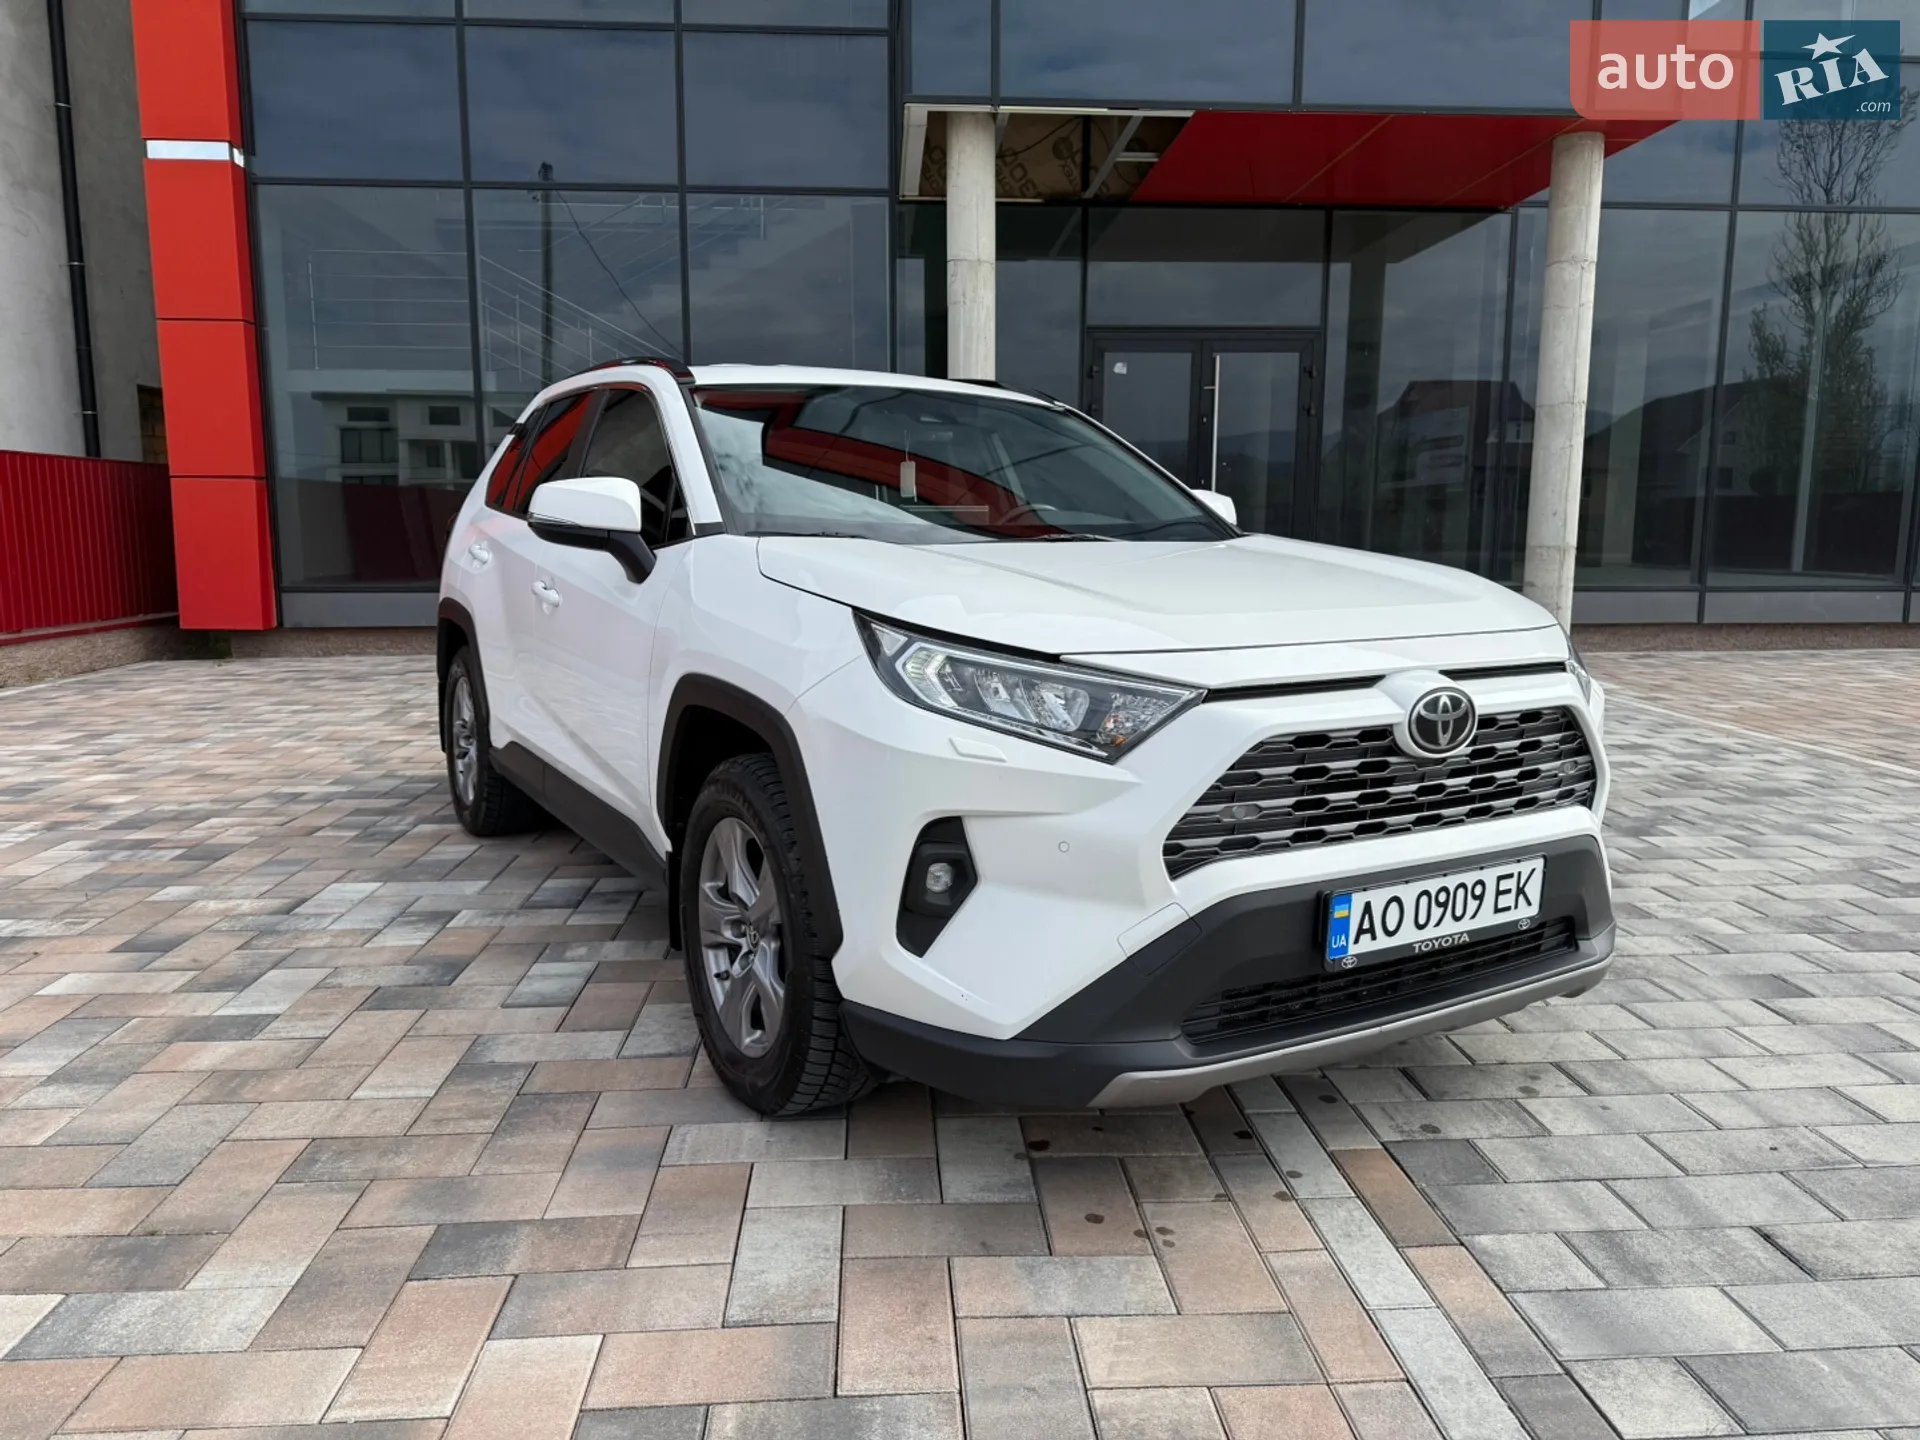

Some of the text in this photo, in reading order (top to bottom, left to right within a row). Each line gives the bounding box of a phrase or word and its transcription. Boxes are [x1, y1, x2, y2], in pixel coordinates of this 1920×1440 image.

[1353, 867, 1537, 945] AO 0909 EK
[1332, 935, 1347, 949] UA
[1412, 932, 1470, 953] TOYOTA
